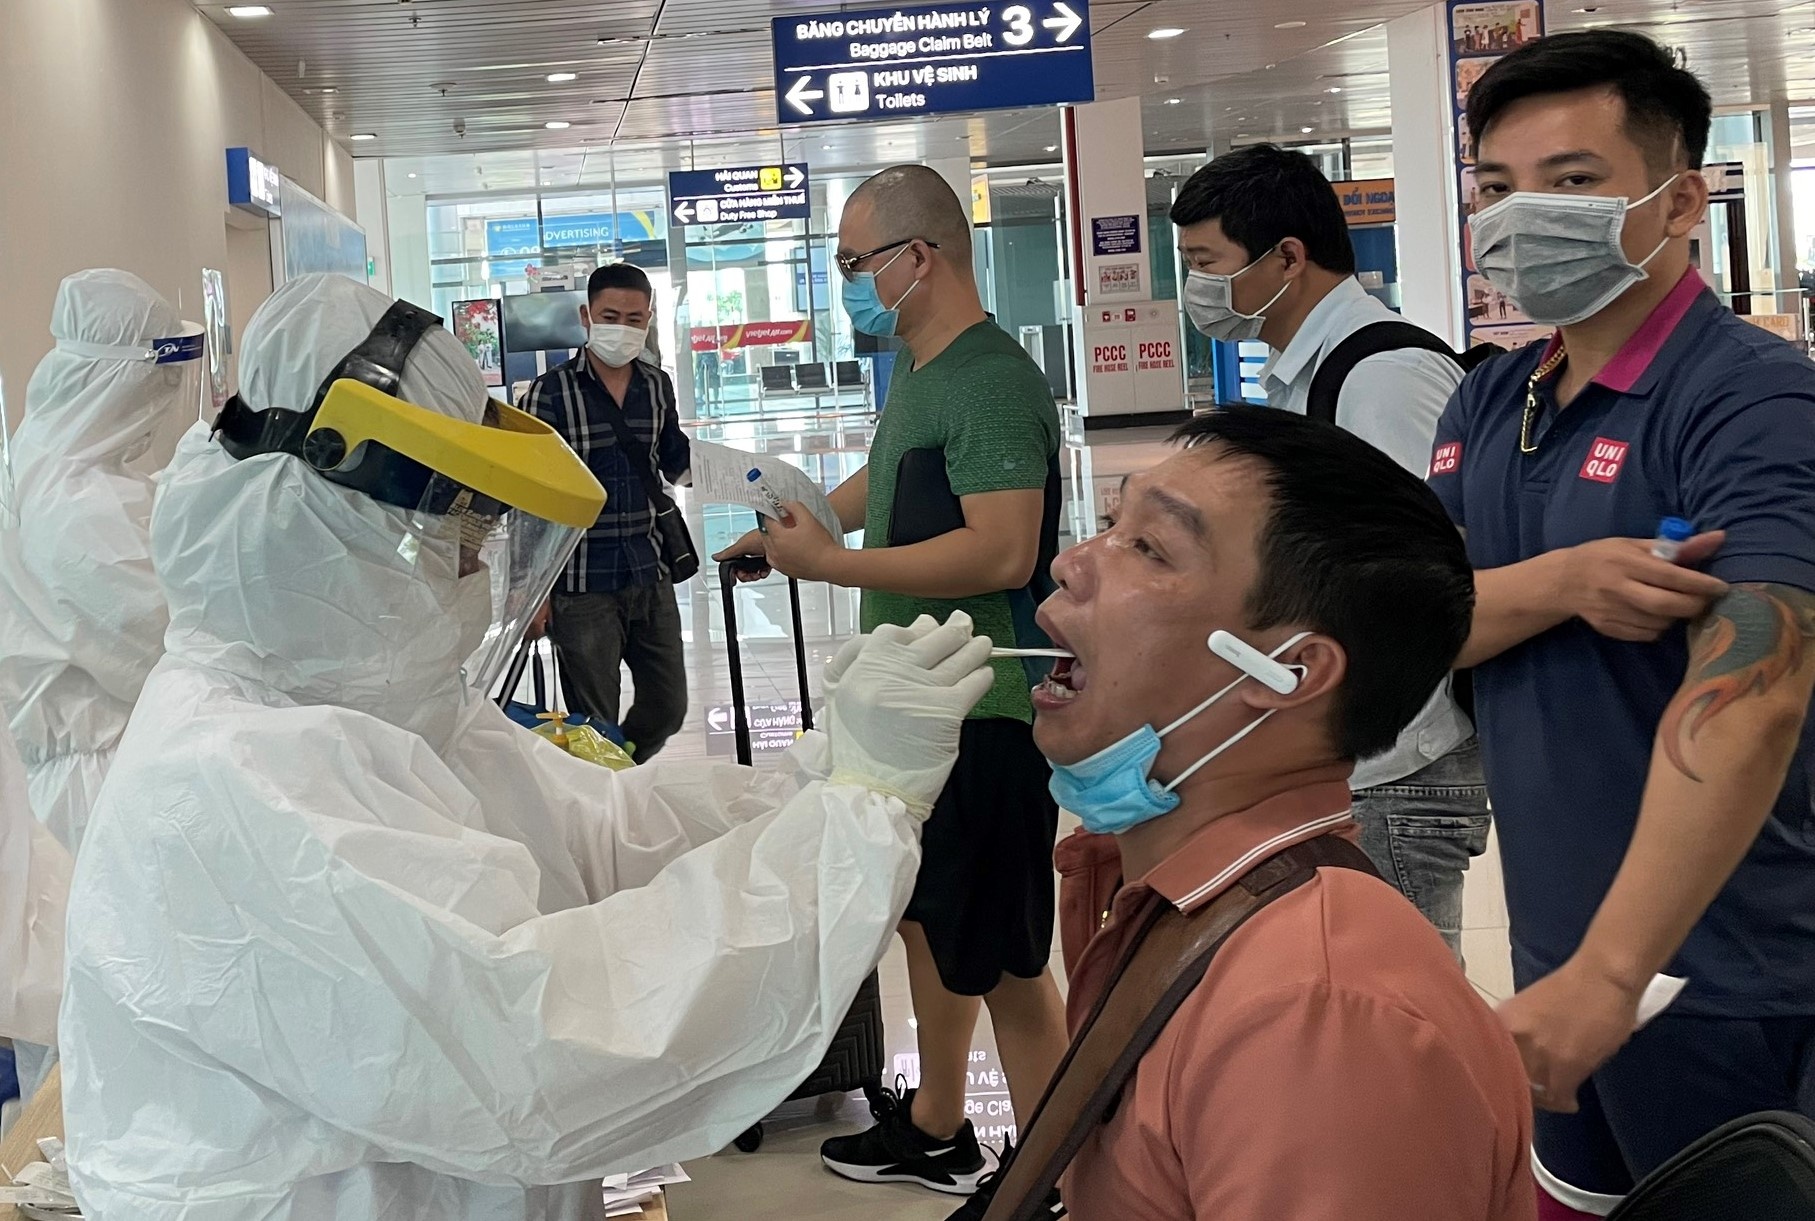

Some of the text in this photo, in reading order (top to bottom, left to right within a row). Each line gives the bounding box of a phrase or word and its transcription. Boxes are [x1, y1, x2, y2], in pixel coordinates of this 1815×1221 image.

[796, 21, 844, 40] BĂNG
[917, 11, 967, 30] HÀNH
[968, 7, 991, 26] LÝ
[1001, 5, 1034, 45] 3
[849, 32, 993, 58] Baggage Claim Belt
[873, 64, 978, 87] KHU VỆ SINH
[875, 92, 926, 109] Toilets
[719, 209, 778, 221] Duty Free Shop
[543, 226, 609, 241] DVERTISING
[1094, 345, 1126, 362] PCCC
[1139, 341, 1171, 359] PCCC
[1436, 446, 1456, 460] UNI
[1594, 443, 1624, 461] UNI
[1433, 457, 1455, 472] QLO
[1586, 459, 1618, 477] QLO
